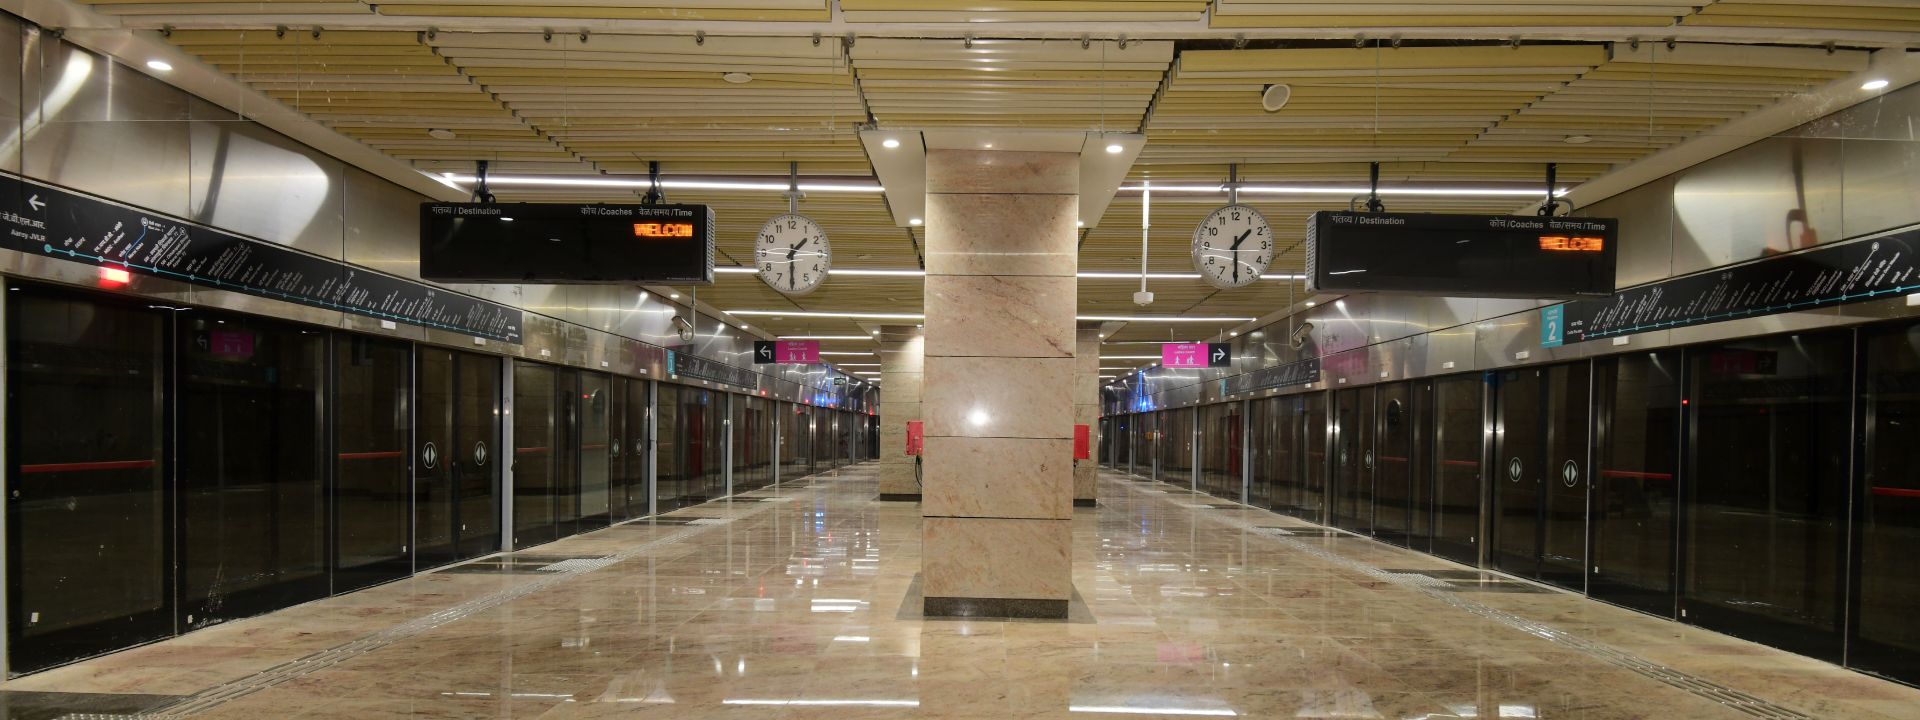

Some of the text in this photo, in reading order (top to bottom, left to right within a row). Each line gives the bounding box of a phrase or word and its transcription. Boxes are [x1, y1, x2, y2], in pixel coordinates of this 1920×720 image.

[458, 207, 501, 215] Destination
[1231, 212, 1240, 220] 12
[1219, 217, 1226, 225] 11
[1248, 217, 1251, 225] 1
[1360, 216, 1405, 225] Destination
[788, 221, 797, 229] 12
[804, 226, 808, 234] 1
[1208, 227, 1218, 236] 10
[1257, 227, 1263, 235] 2
[766, 235, 774, 244] 10
[813, 236, 819, 244] 2
[1204, 242, 1210, 250] 9
[1261, 241, 1267, 249] 3
[761, 249, 767, 257] 9
[1208, 256, 1214, 264] 8
[1256, 256, 1262, 264] 4
[766, 263, 772, 271] 8
[813, 263, 819, 272] 4
[1220, 266, 1225, 274] 7
[1247, 266, 1253, 274] 5
[777, 273, 782, 281] 7
[803, 273, 809, 281] 5
[1548, 321, 1556, 341] 2
